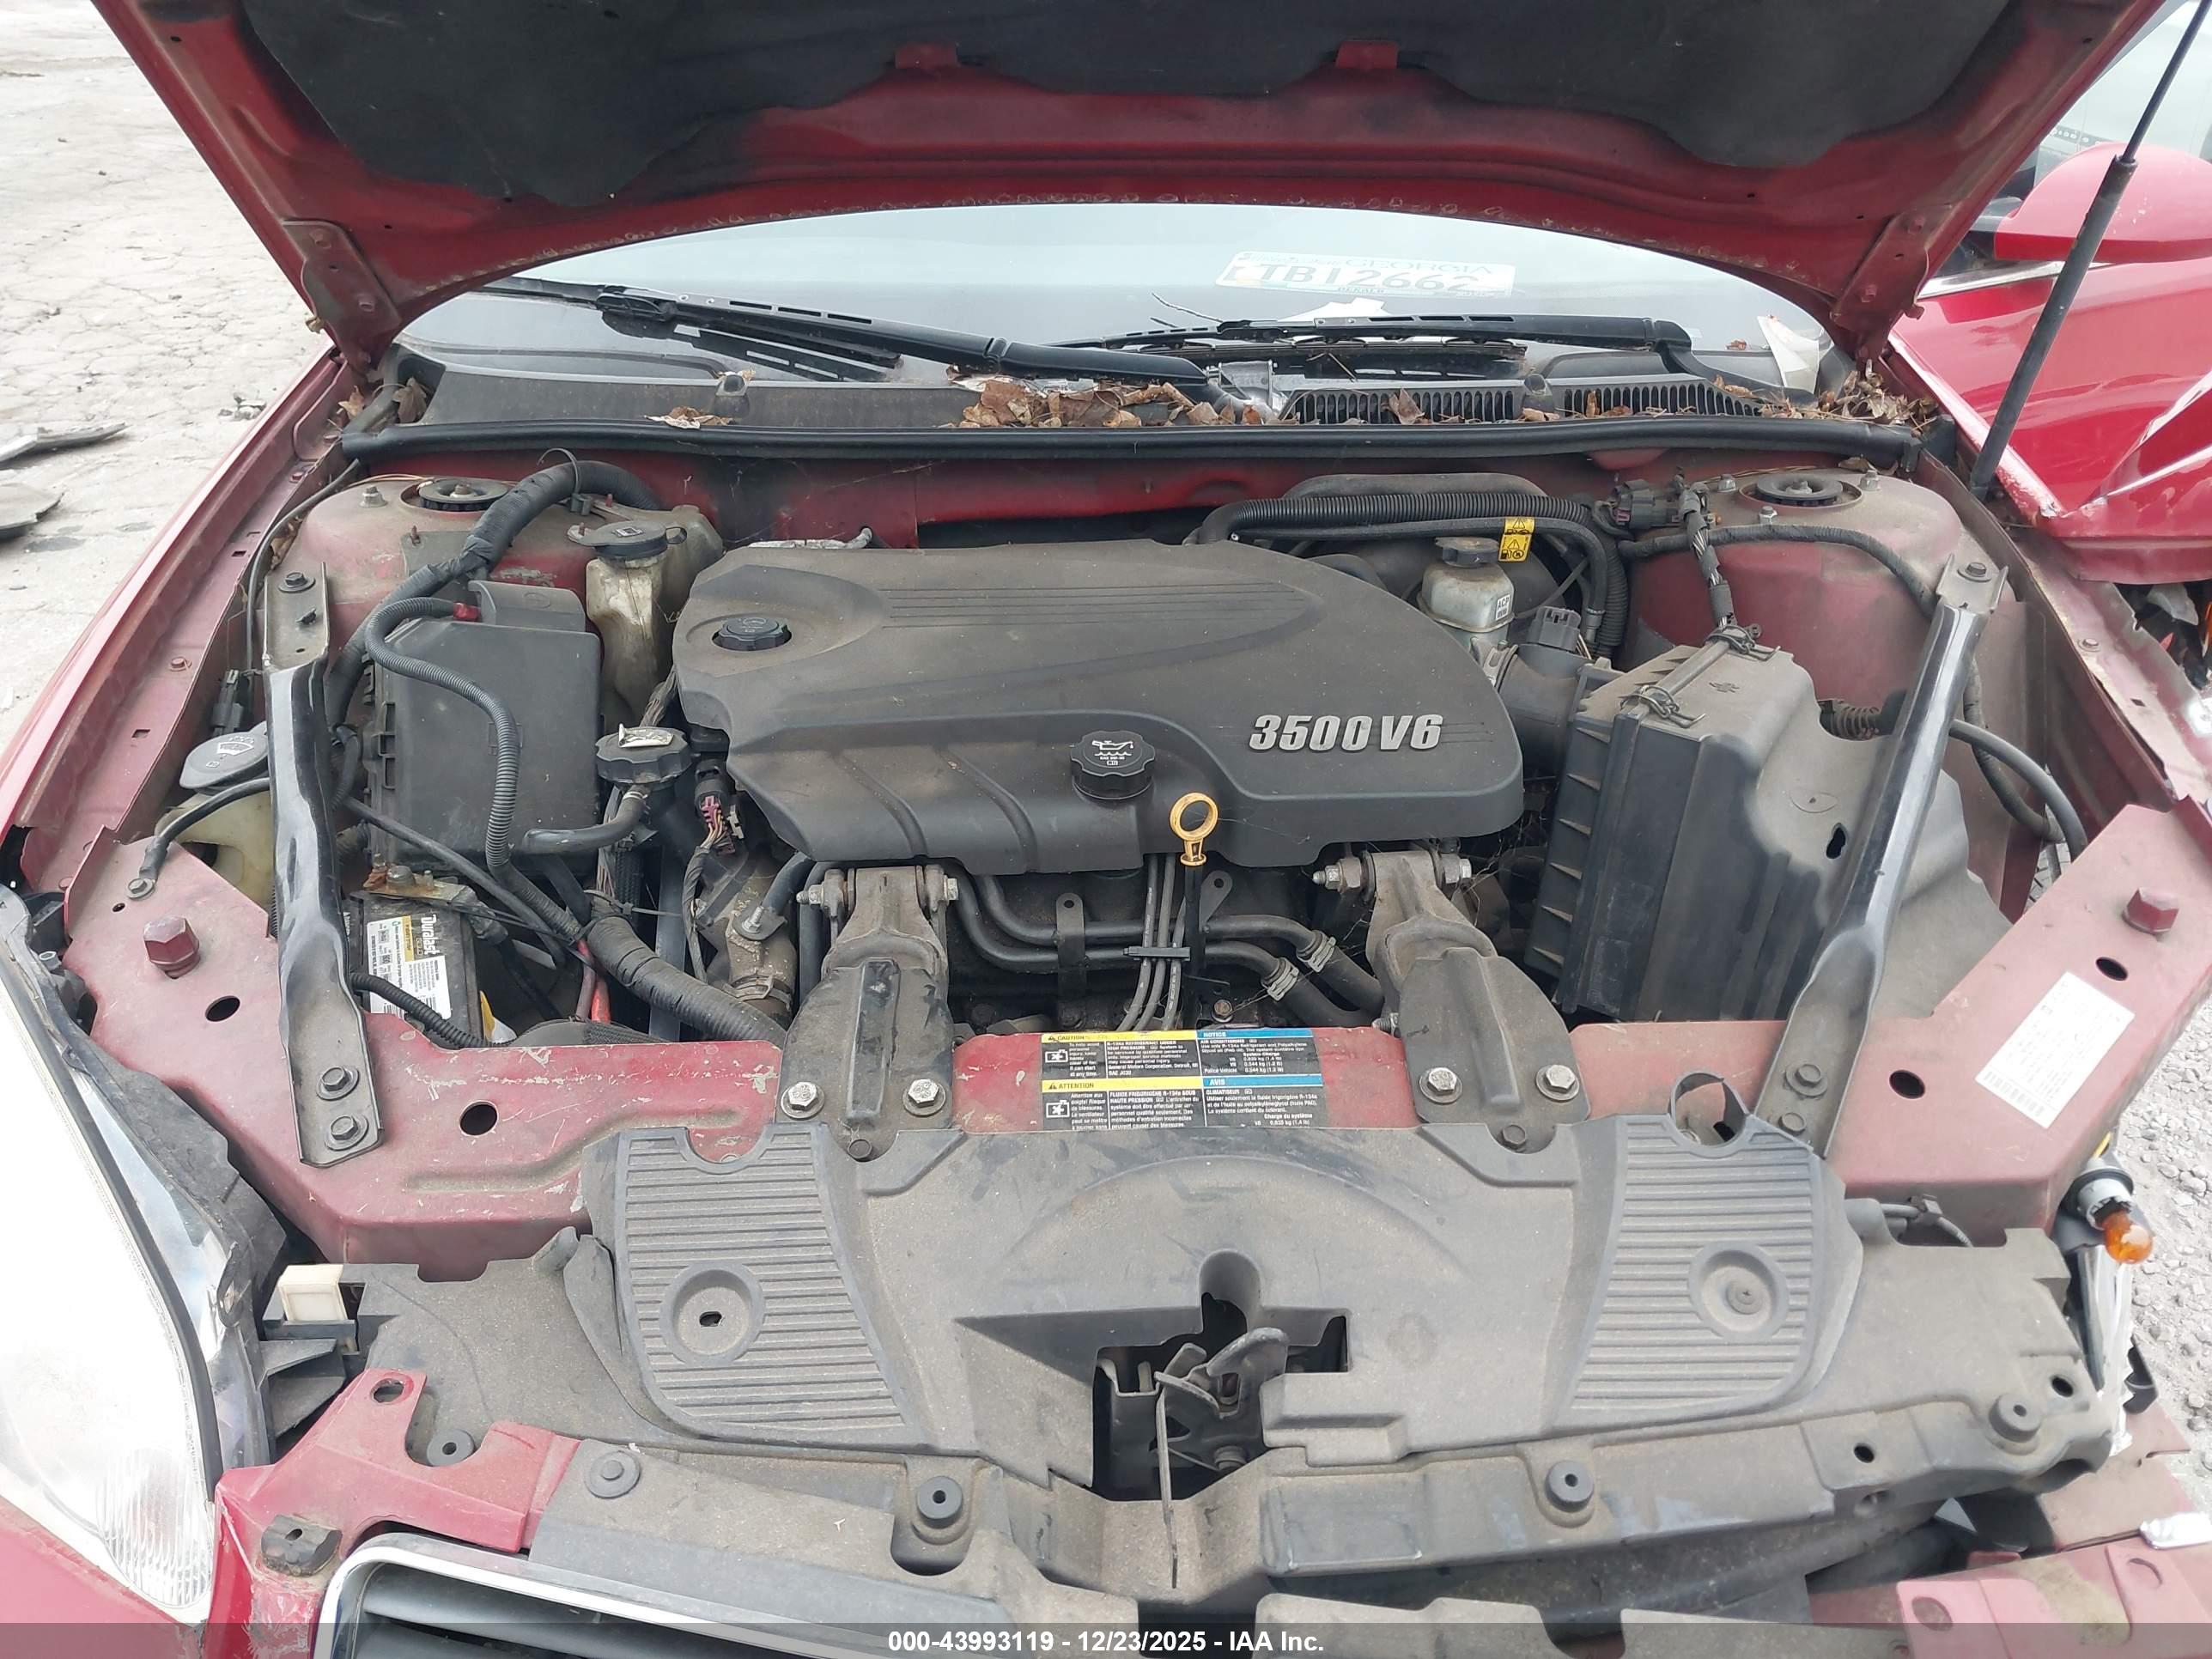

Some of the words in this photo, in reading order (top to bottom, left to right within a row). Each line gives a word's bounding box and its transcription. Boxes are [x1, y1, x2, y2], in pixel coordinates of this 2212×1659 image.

[1346, 258, 1492, 274] GEORGIA
[1249, 714, 1373, 751] 3500
[1380, 714, 1443, 750] V6
[421, 915, 441, 955] Duralast
